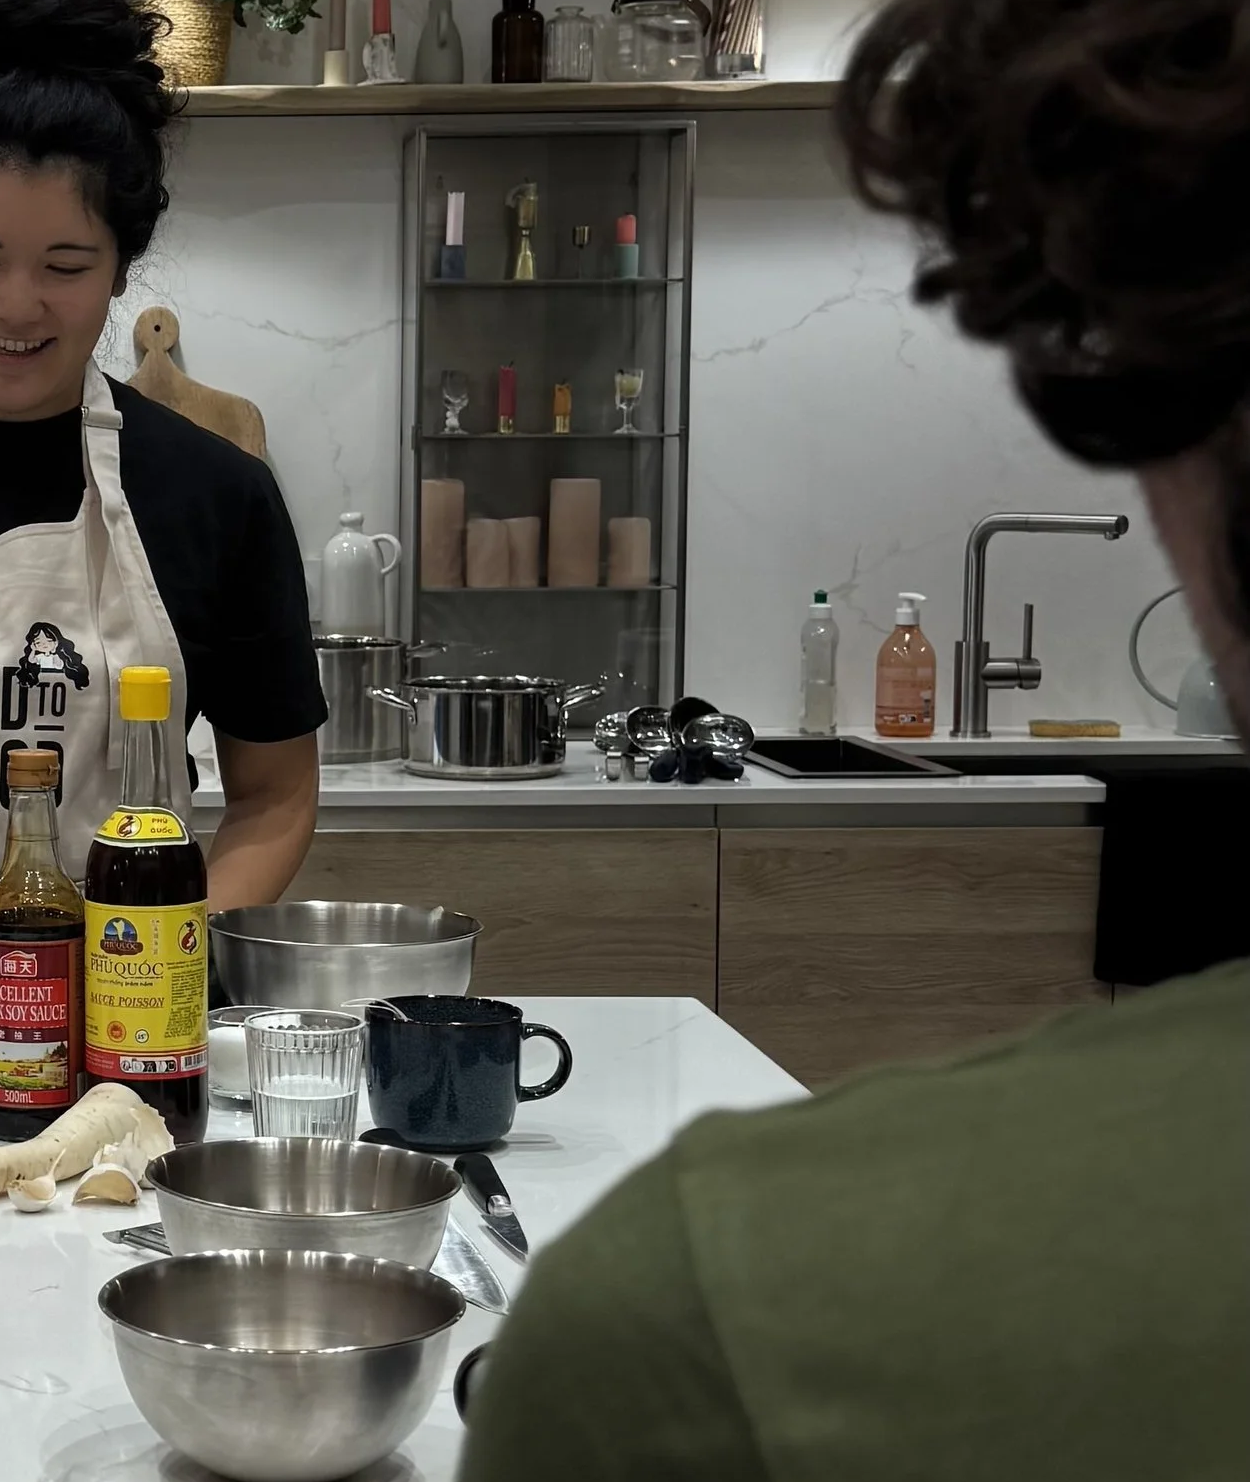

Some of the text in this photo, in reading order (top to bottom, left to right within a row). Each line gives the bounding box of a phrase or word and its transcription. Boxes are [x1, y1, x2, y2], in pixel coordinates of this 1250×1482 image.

[37, 681, 67, 717] TO
[90, 991, 165, 1008] SAUCE POISSON
[5, 1003, 29, 1022] SOY
[29, 1003, 67, 1022] SAUCE
[4, 1090, 35, 1103] 500mL
